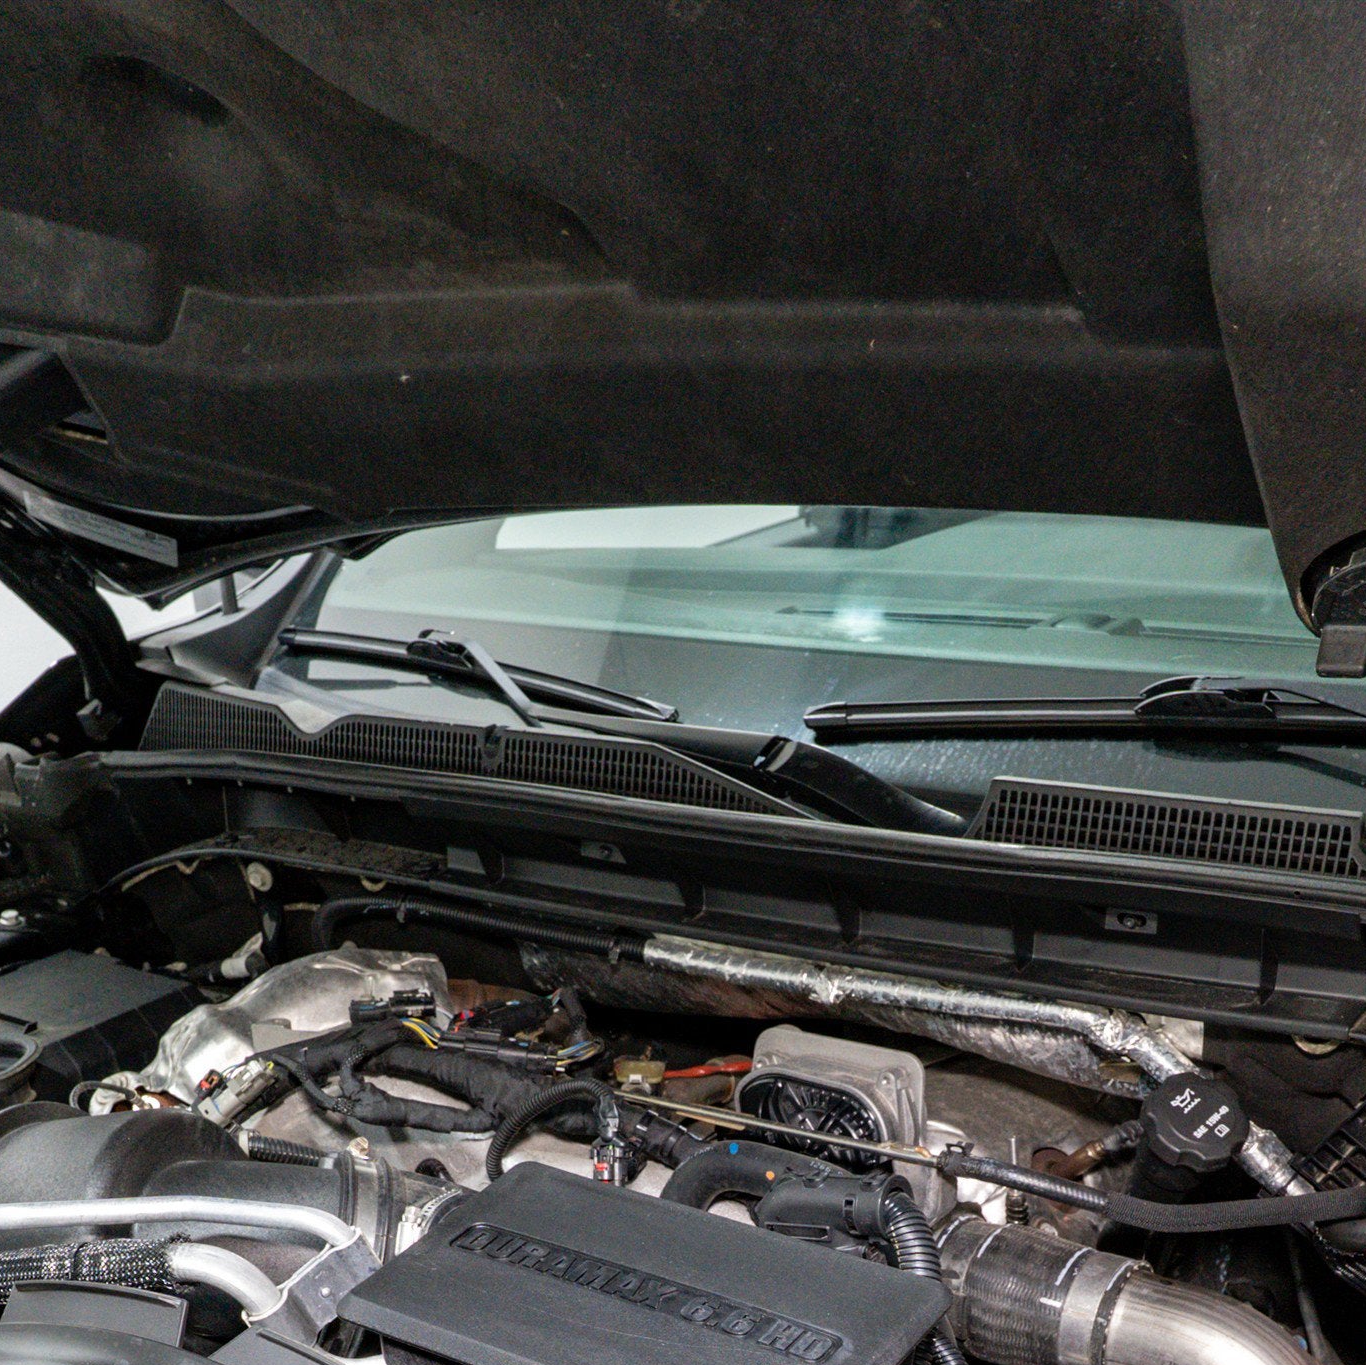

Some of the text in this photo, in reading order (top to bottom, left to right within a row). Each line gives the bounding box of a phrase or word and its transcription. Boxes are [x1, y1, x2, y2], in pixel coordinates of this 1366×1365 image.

[1193, 1105, 1229, 1138] SAE 15W-40
[455, 1226, 836, 1364] DURAMAX 6.6 HD
